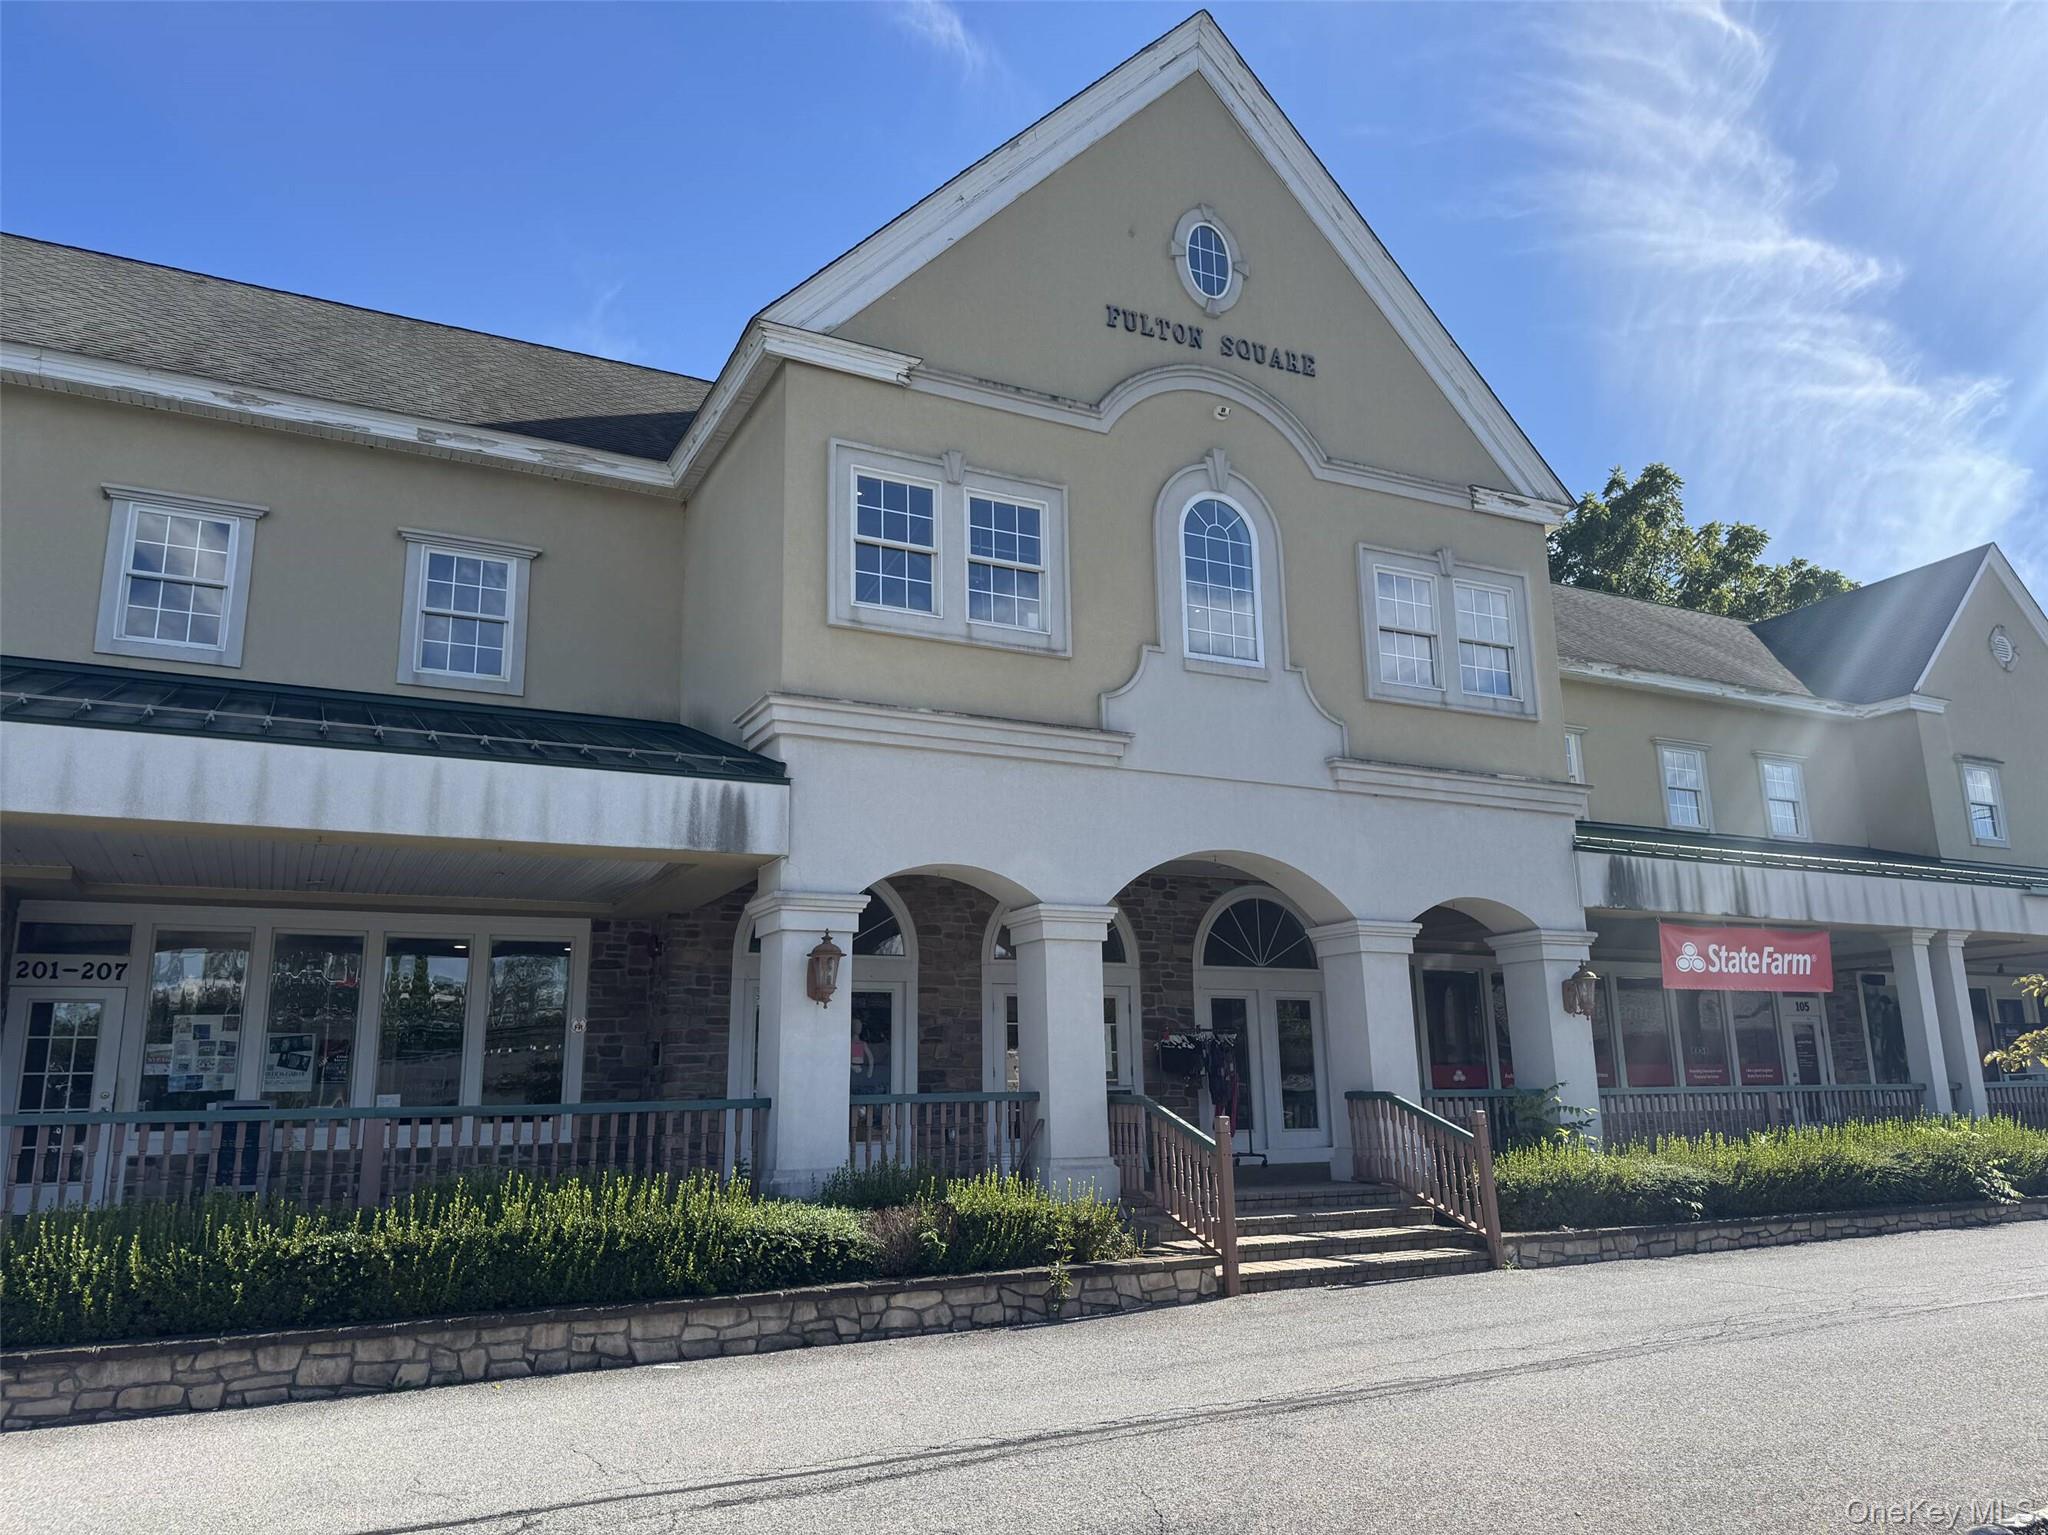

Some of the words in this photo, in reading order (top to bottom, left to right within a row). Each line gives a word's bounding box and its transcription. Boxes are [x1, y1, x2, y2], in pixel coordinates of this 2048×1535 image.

[1106, 304, 1204, 350] FULTON
[1220, 334, 1316, 377] SQUARE
[15, 960, 129, 981] 201-207
[1795, 1001, 1810, 1012] 105
